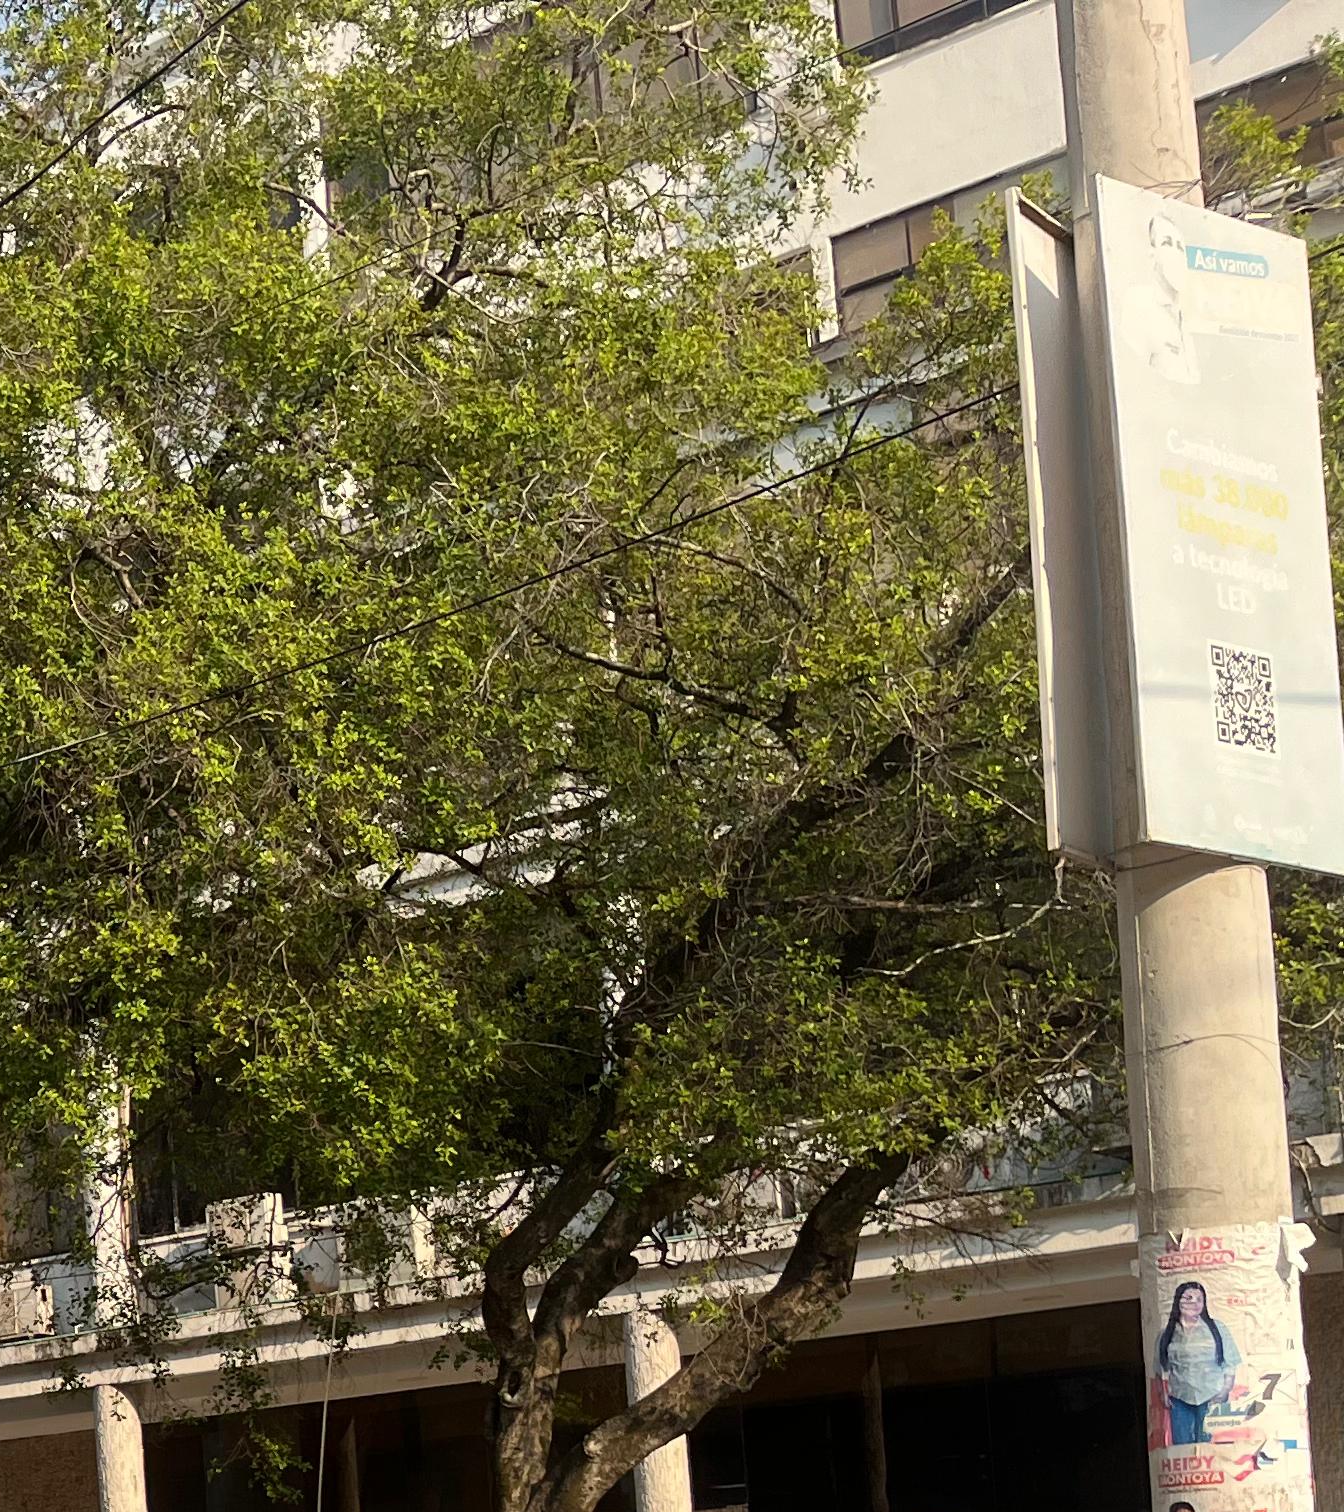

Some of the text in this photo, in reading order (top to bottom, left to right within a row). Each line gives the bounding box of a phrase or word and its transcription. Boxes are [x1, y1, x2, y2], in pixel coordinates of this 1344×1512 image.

[1194, 248, 1265, 277] Así vamos
[1167, 428, 1278, 482] Cambiamos
[1172, 544, 1185, 564] a
[1217, 582, 1258, 615] LED
[1259, 1373, 1282, 1401] 7
[1161, 1455, 1215, 1473] HEIDY
